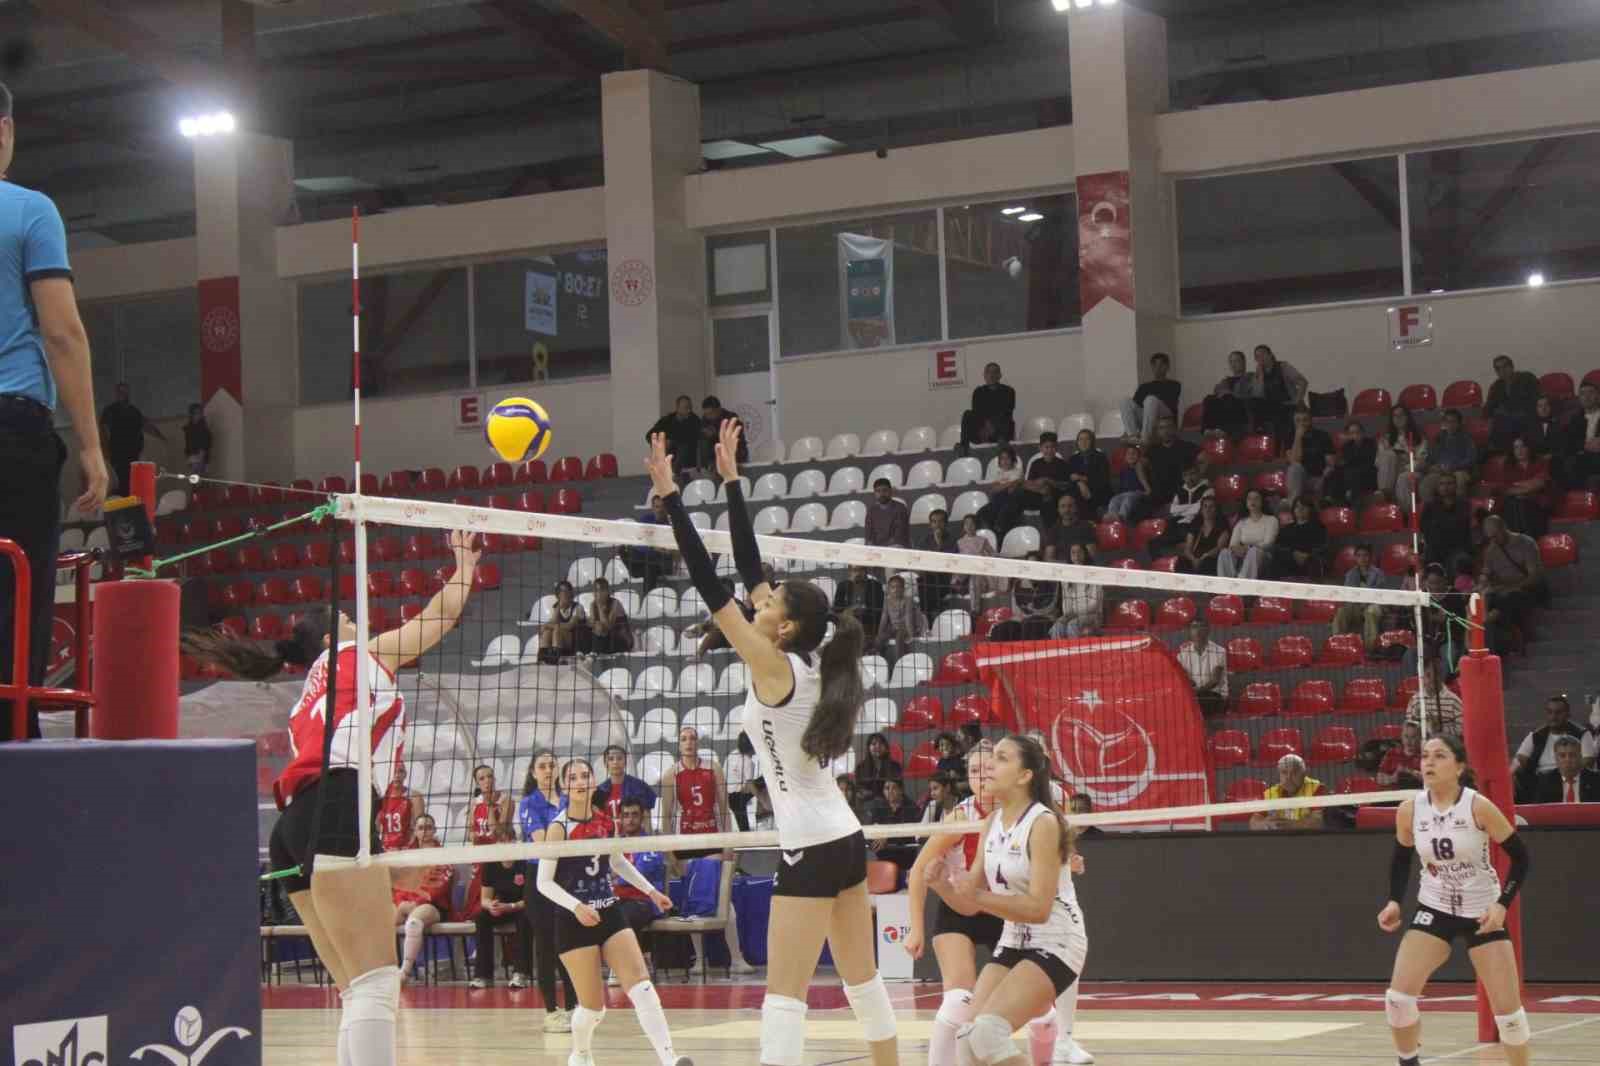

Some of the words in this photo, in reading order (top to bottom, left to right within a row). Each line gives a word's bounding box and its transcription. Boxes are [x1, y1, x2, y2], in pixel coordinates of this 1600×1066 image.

[1399, 307, 1418, 336] F
[937, 351, 957, 378] E
[461, 398, 478, 422] E
[691, 786, 703, 806] 5
[385, 812, 401, 833] 13
[1431, 838, 1455, 861] 18
[585, 855, 600, 876] 3
[996, 864, 1009, 889] 4
[1413, 911, 1434, 925] 18
